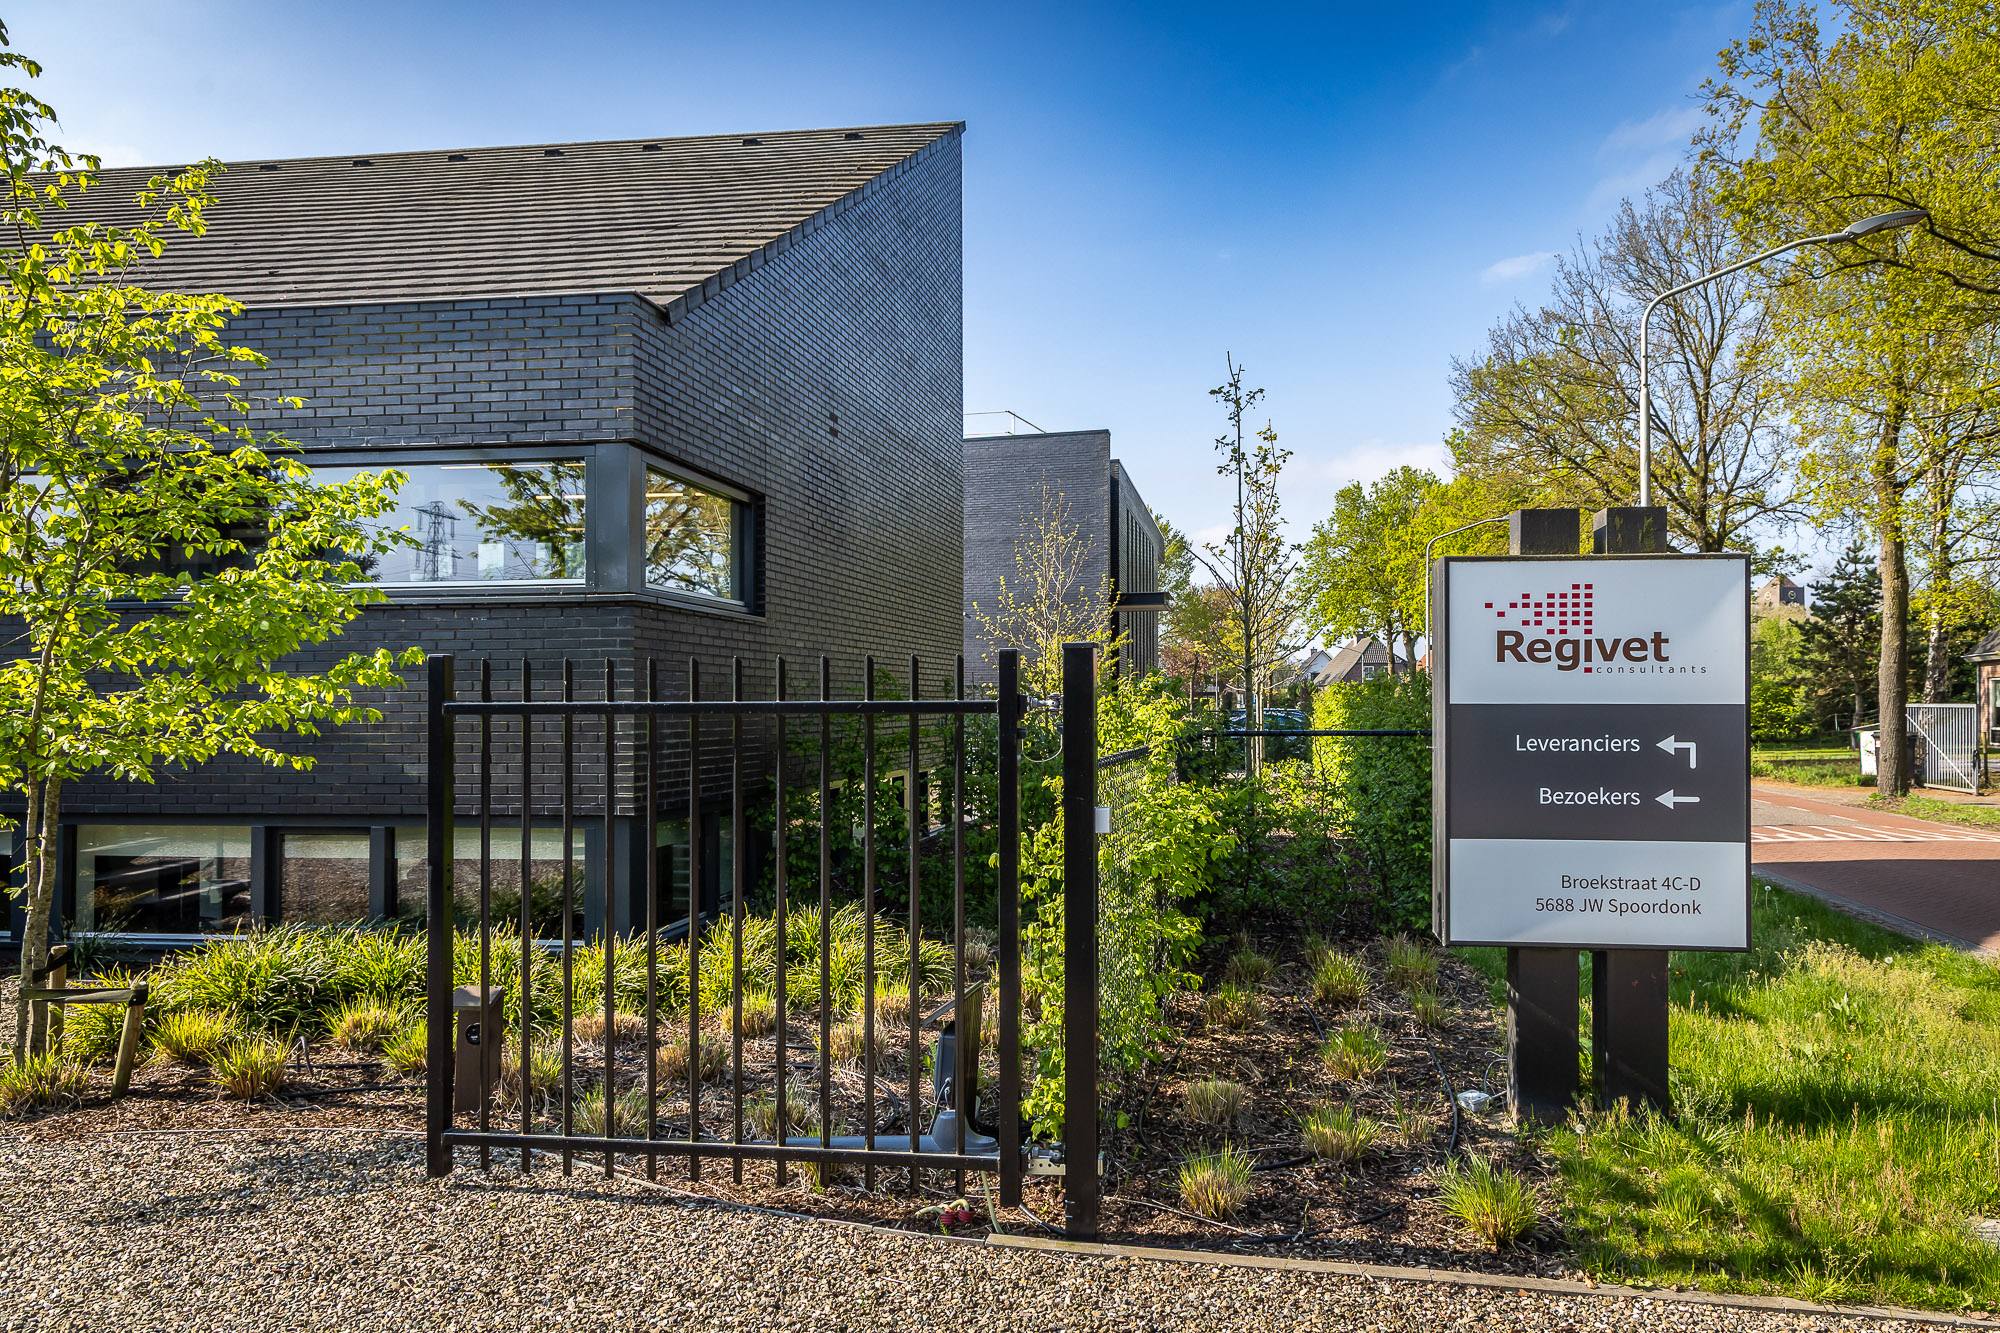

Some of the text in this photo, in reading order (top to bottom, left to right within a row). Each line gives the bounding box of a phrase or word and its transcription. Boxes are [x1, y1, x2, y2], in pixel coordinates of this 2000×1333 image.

[1496, 630, 1670, 672] Regivet
[1596, 665, 1708, 674] consultants
[1515, 733, 1641, 752] Leveranciers
[1539, 787, 1641, 806] Bezoekers
[1561, 874, 1701, 892] Broekstraat 4C-D
[1535, 897, 1702, 916] 5688 JW Spoordonk
